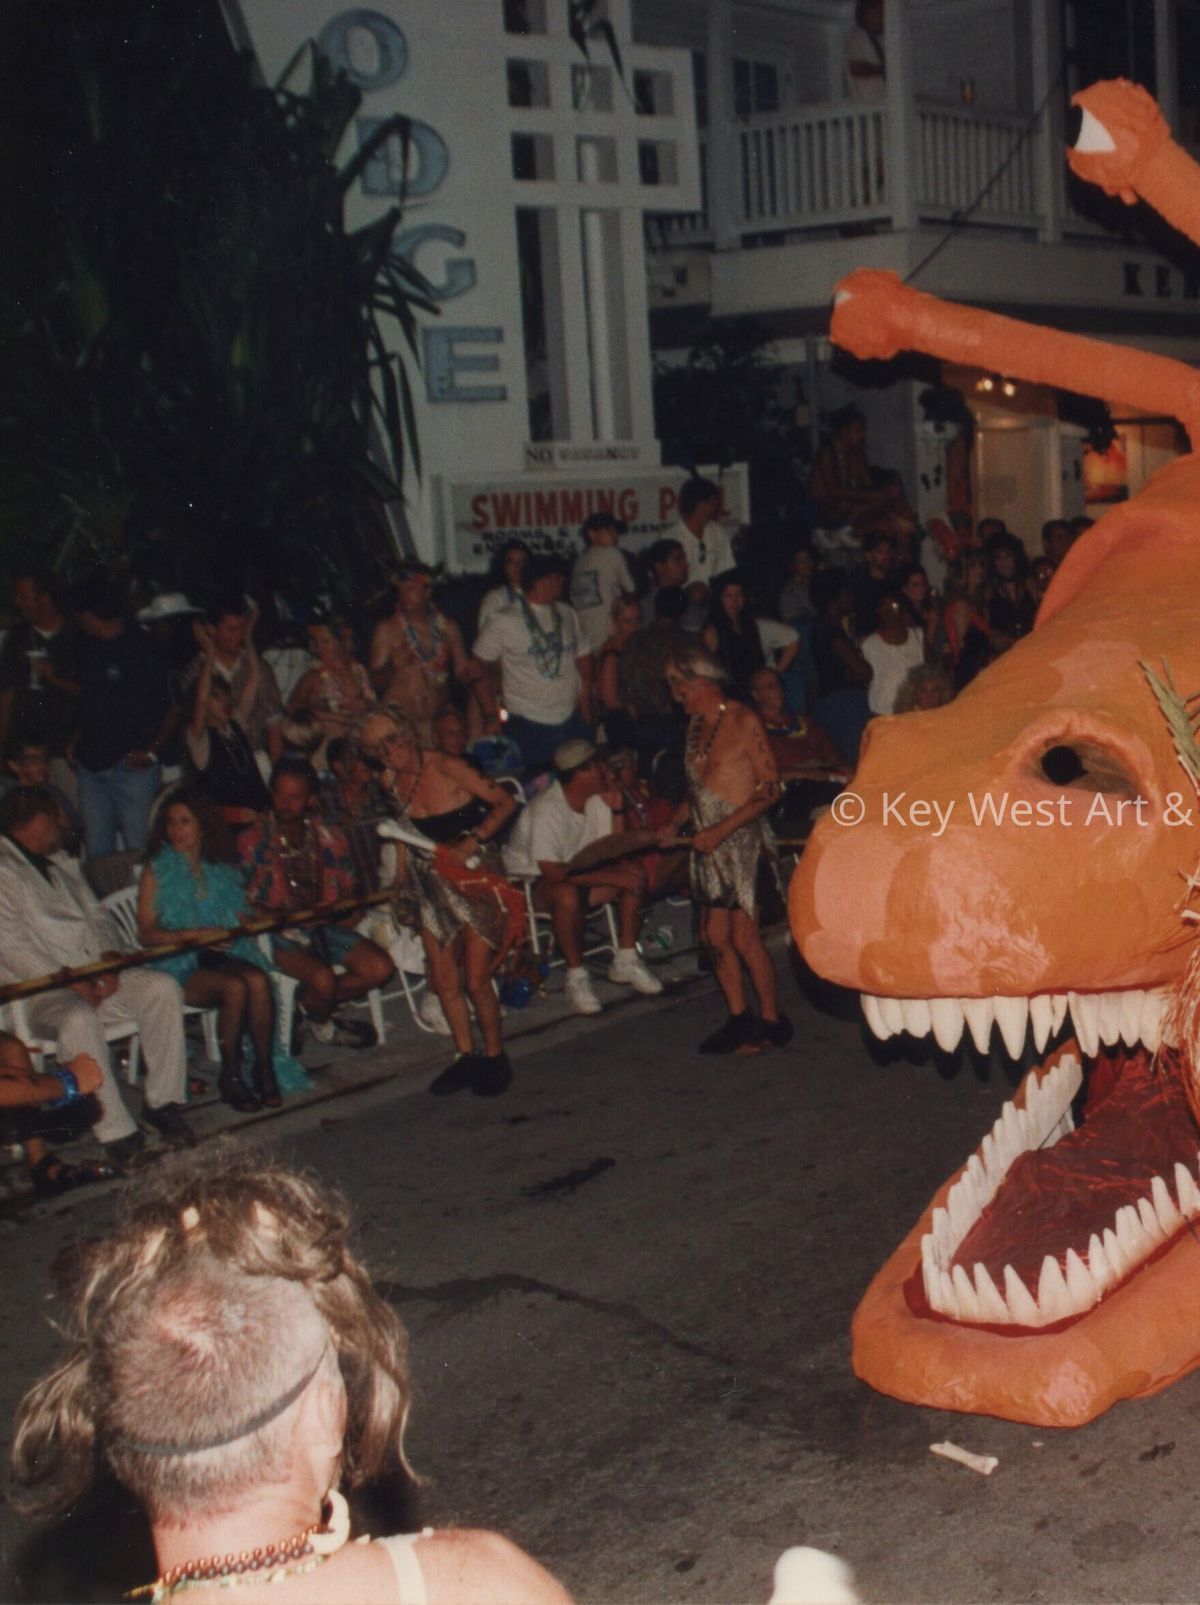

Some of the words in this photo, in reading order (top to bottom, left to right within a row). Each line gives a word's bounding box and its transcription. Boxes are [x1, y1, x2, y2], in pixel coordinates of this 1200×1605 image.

[525, 447, 552, 461] NO
[471, 487, 639, 530] SWIMMING
[659, 486, 731, 520] PL
